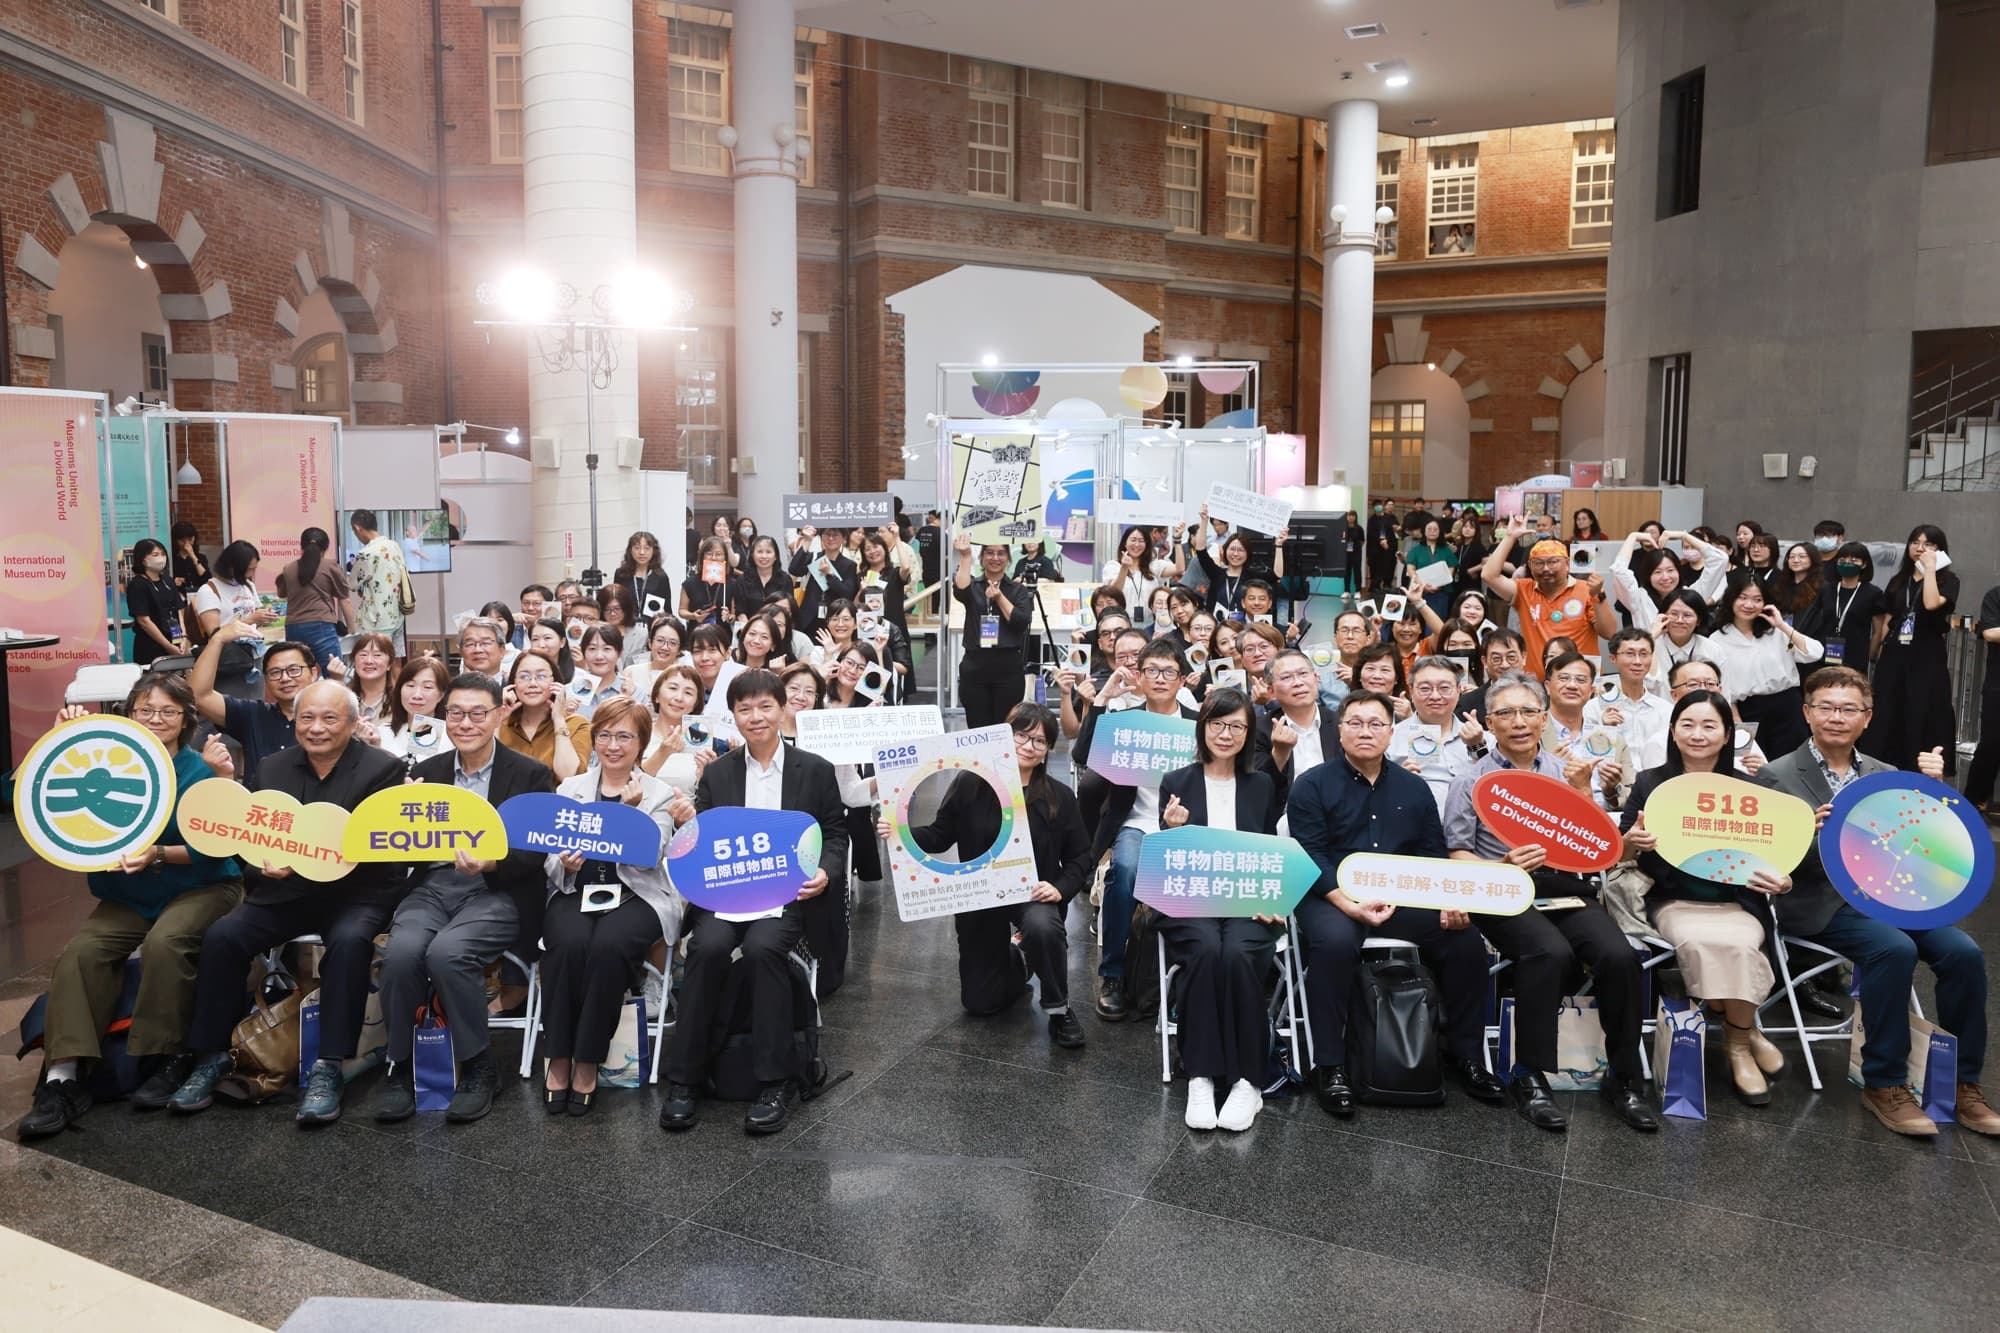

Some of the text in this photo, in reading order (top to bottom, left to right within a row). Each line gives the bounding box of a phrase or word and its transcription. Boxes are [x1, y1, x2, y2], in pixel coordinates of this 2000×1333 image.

[65, 419, 79, 508] Museums Uniting
[308, 437, 318, 504] Museums Uniting
[53, 440, 67, 521] a Divided World
[301, 489, 309, 513] World
[260, 538, 301, 546] Internation
[261, 549, 292, 557] Museum
[3, 555, 65, 565] International
[5, 569, 66, 580] Museum Day
[55, 650, 101, 661] Inclusion,
[7, 664, 31, 673] eace
[802, 711, 937, 731] 臺南國家美術館
[803, 732, 859, 742] PREPARATORY
[861, 730, 889, 739] OFFICE
[804, 741, 841, 750] MUSEUM
[956, 733, 989, 748] ICOM
[1113, 728, 1198, 753] 博物館聯
[878, 745, 917, 760] 2026
[400, 801, 450, 823] 平權
[1697, 792, 1758, 816] 518
[245, 804, 294, 834] 永續
[555, 808, 603, 835] 共融
[1490, 784, 1611, 851] Museums Uniting
[1682, 816, 1773, 836] 國際博物館日
[189, 817, 343, 864] SUSTAINABILITY
[370, 830, 486, 852] EQUITY
[1491, 802, 1599, 860] a Divided World
[1692, 832, 1731, 840] International
[527, 831, 623, 856] INCLUSION
[713, 832, 771, 860] 518
[703, 854, 787, 881] 國際博物館日
[1163, 848, 1284, 873] 博物館聯結
[715, 877, 752, 887] International
[752, 873, 776, 881] Museum
[1162, 875, 1283, 900] 歧異的世界
